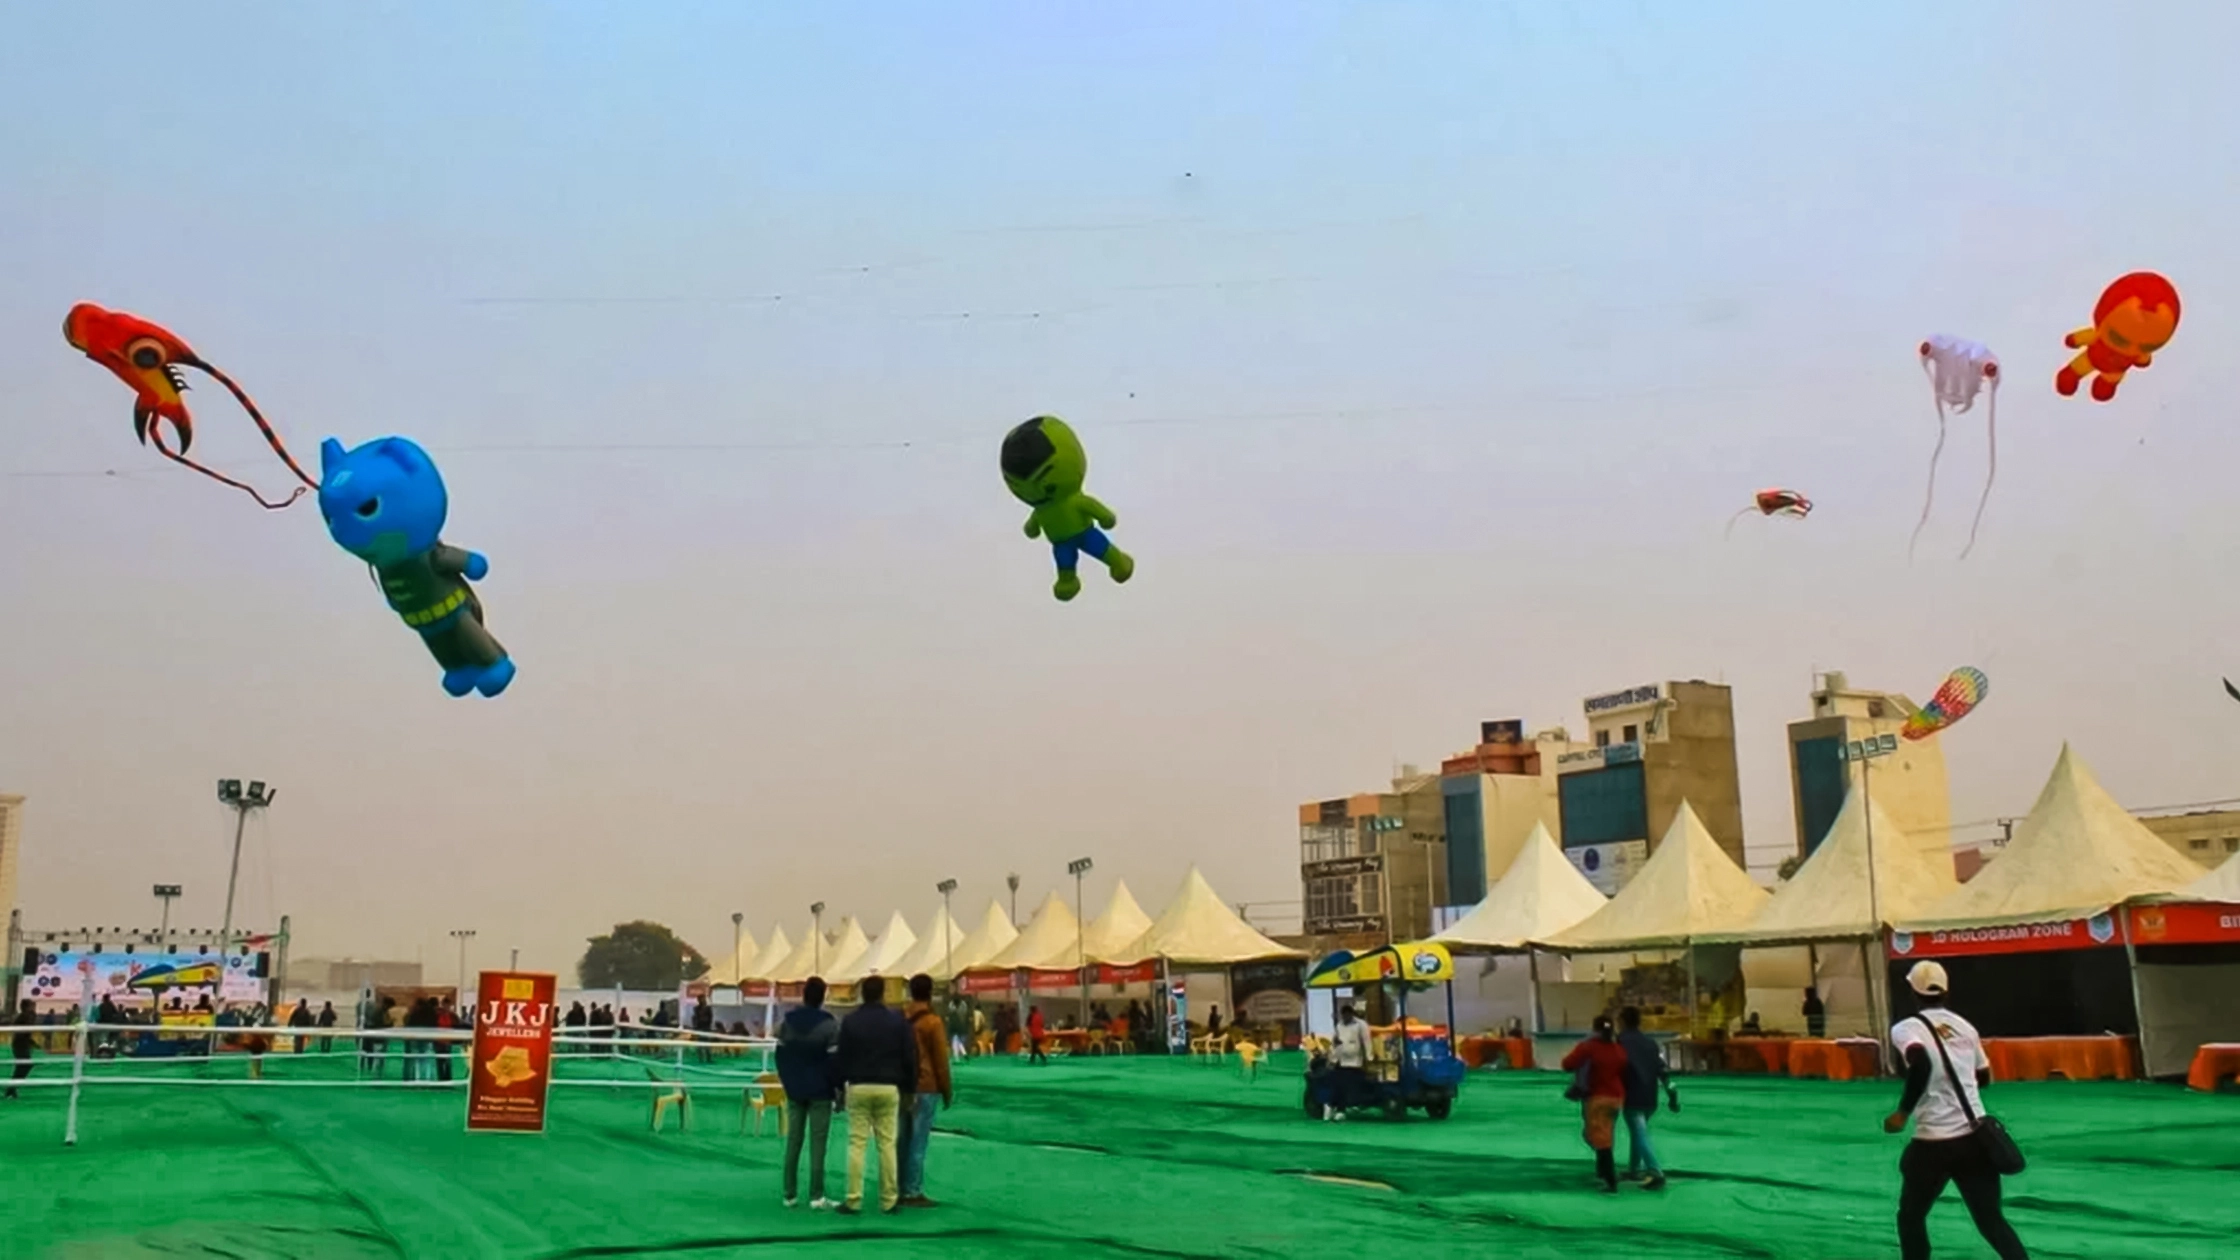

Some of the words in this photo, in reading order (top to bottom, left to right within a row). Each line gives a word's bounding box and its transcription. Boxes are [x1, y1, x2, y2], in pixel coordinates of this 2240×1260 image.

[1951, 926, 2029, 943] HOLOGRAM
[2033, 922, 2074, 937] ZONE
[481, 1000, 549, 1027] JKJ
[486, 1026, 541, 1039] JEWELLERS
